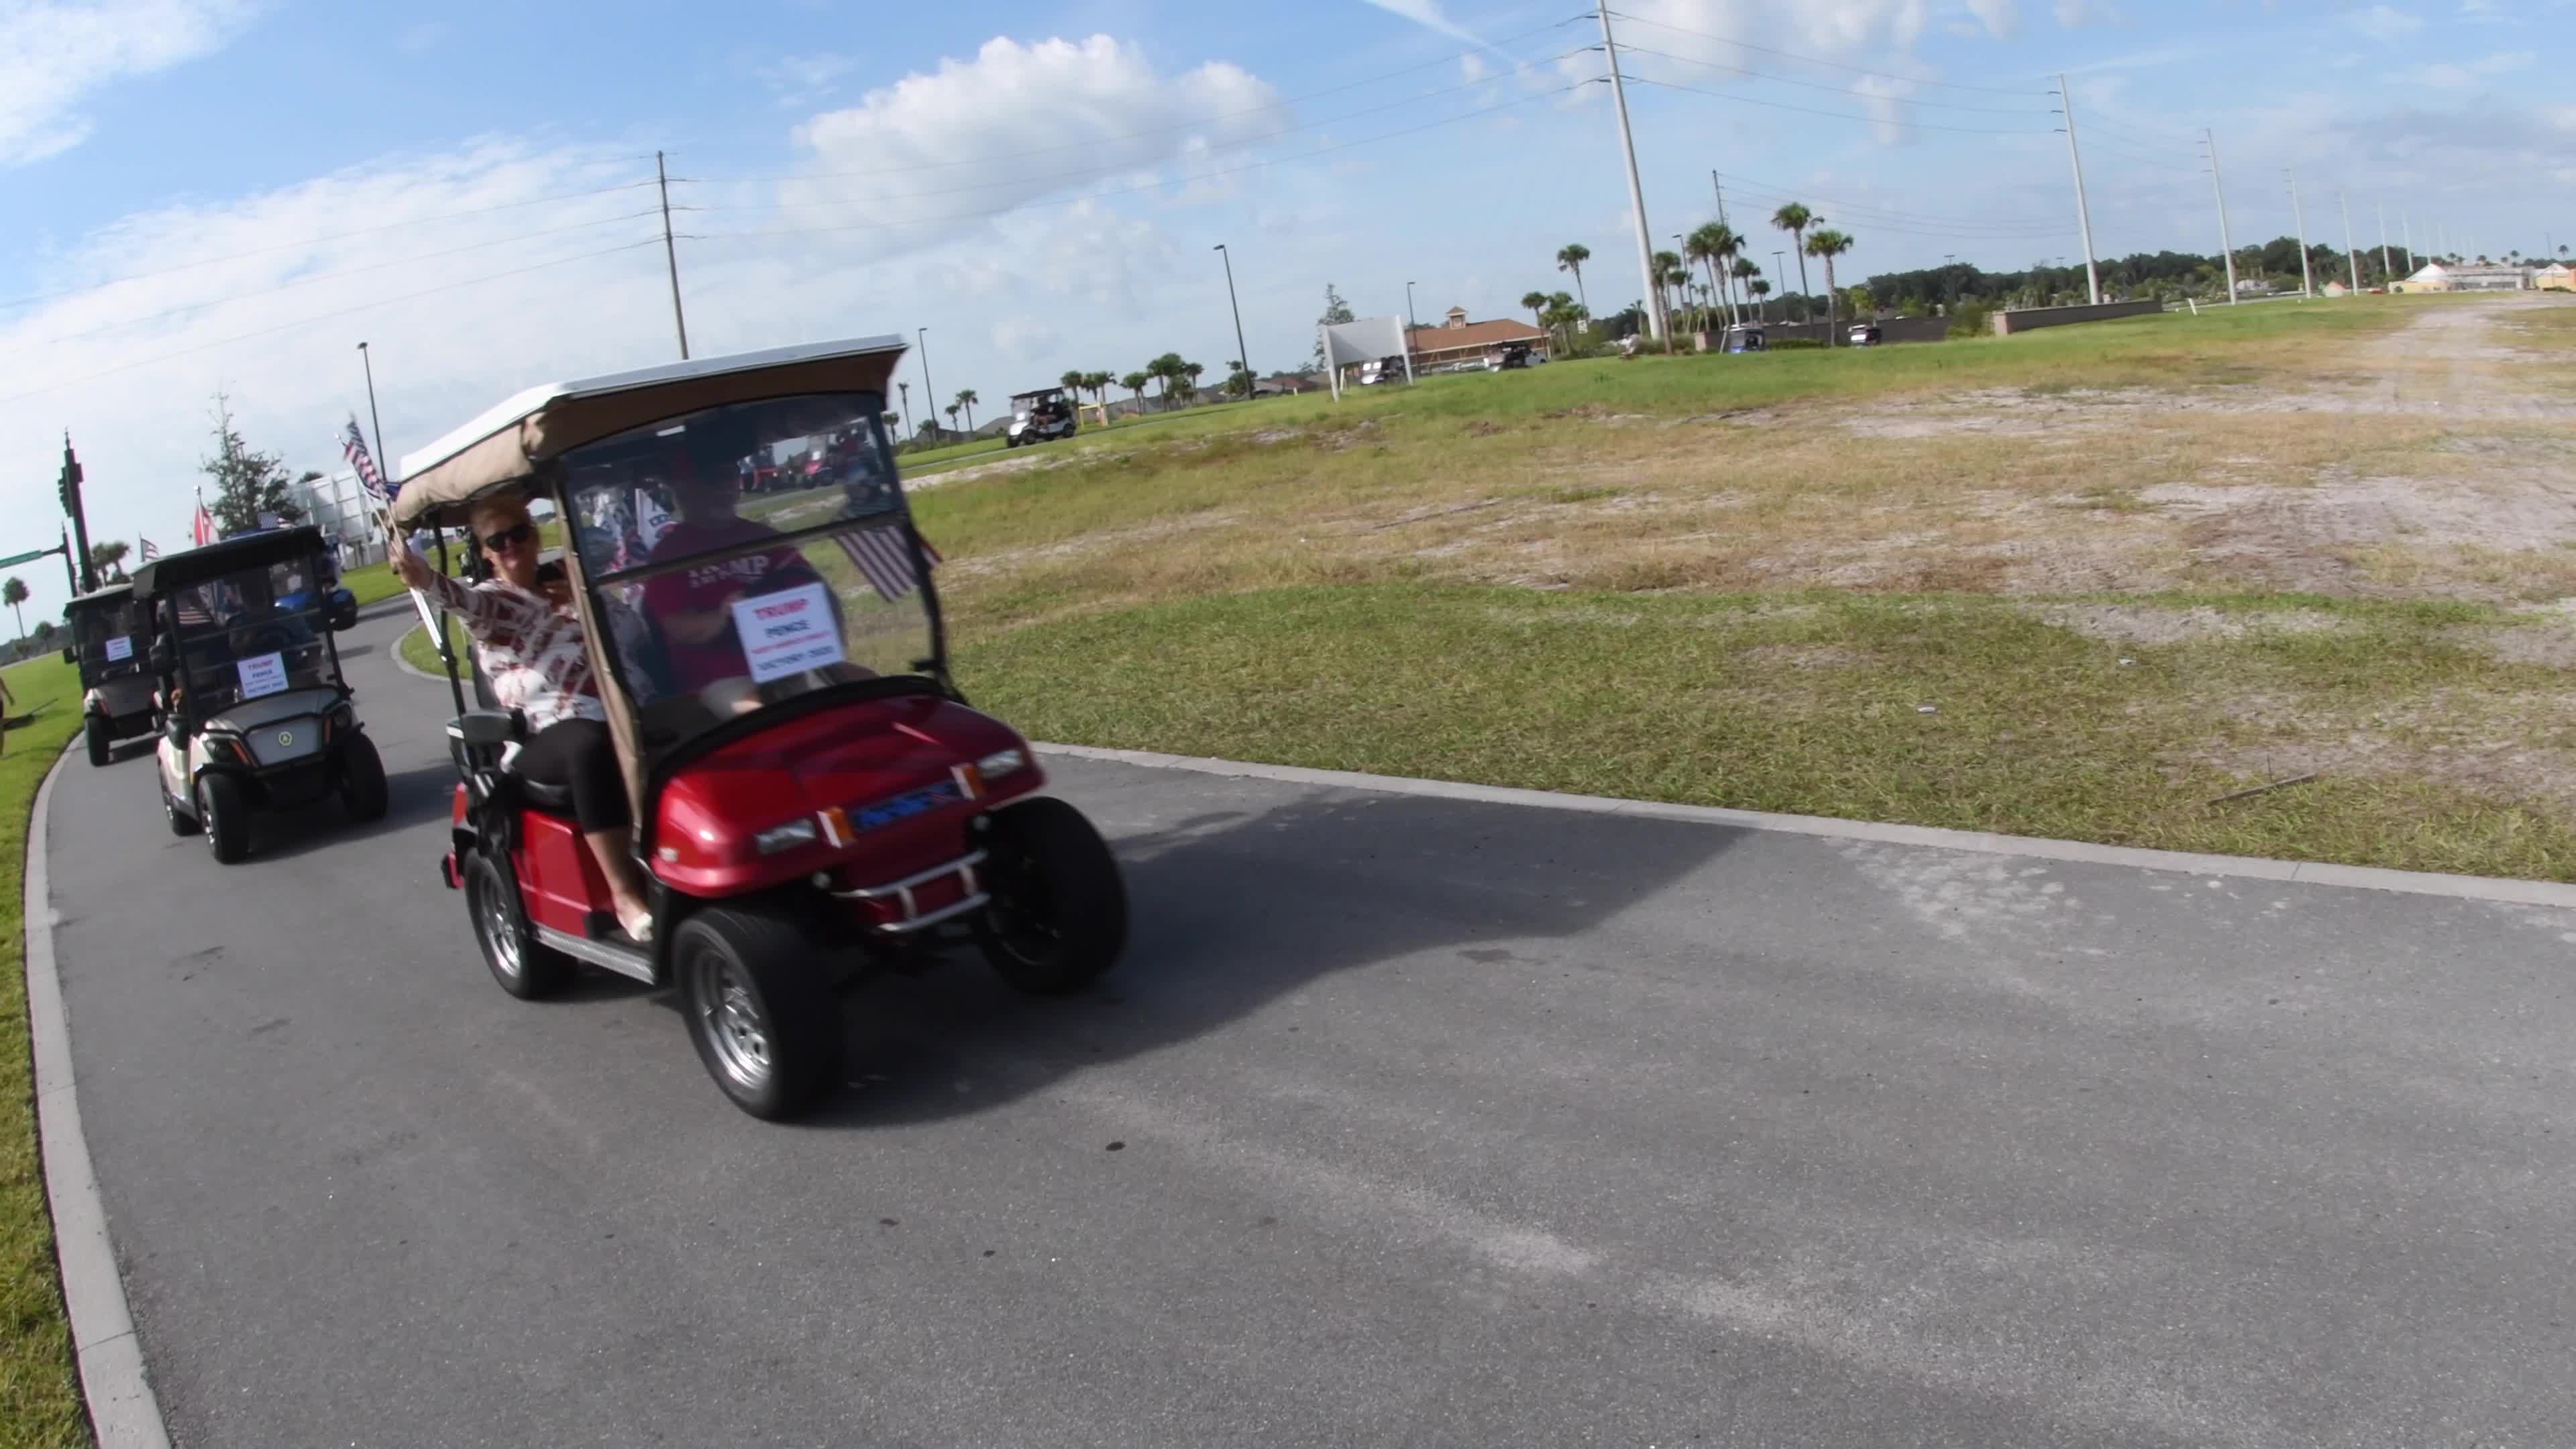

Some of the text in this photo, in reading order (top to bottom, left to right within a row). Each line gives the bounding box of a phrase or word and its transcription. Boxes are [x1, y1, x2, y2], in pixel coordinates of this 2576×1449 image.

[753, 598, 810, 620] TRUMP
[765, 619, 810, 638] PENCE
[247, 659, 274, 670] TRUMP
[252, 669, 273, 678] PENCE
